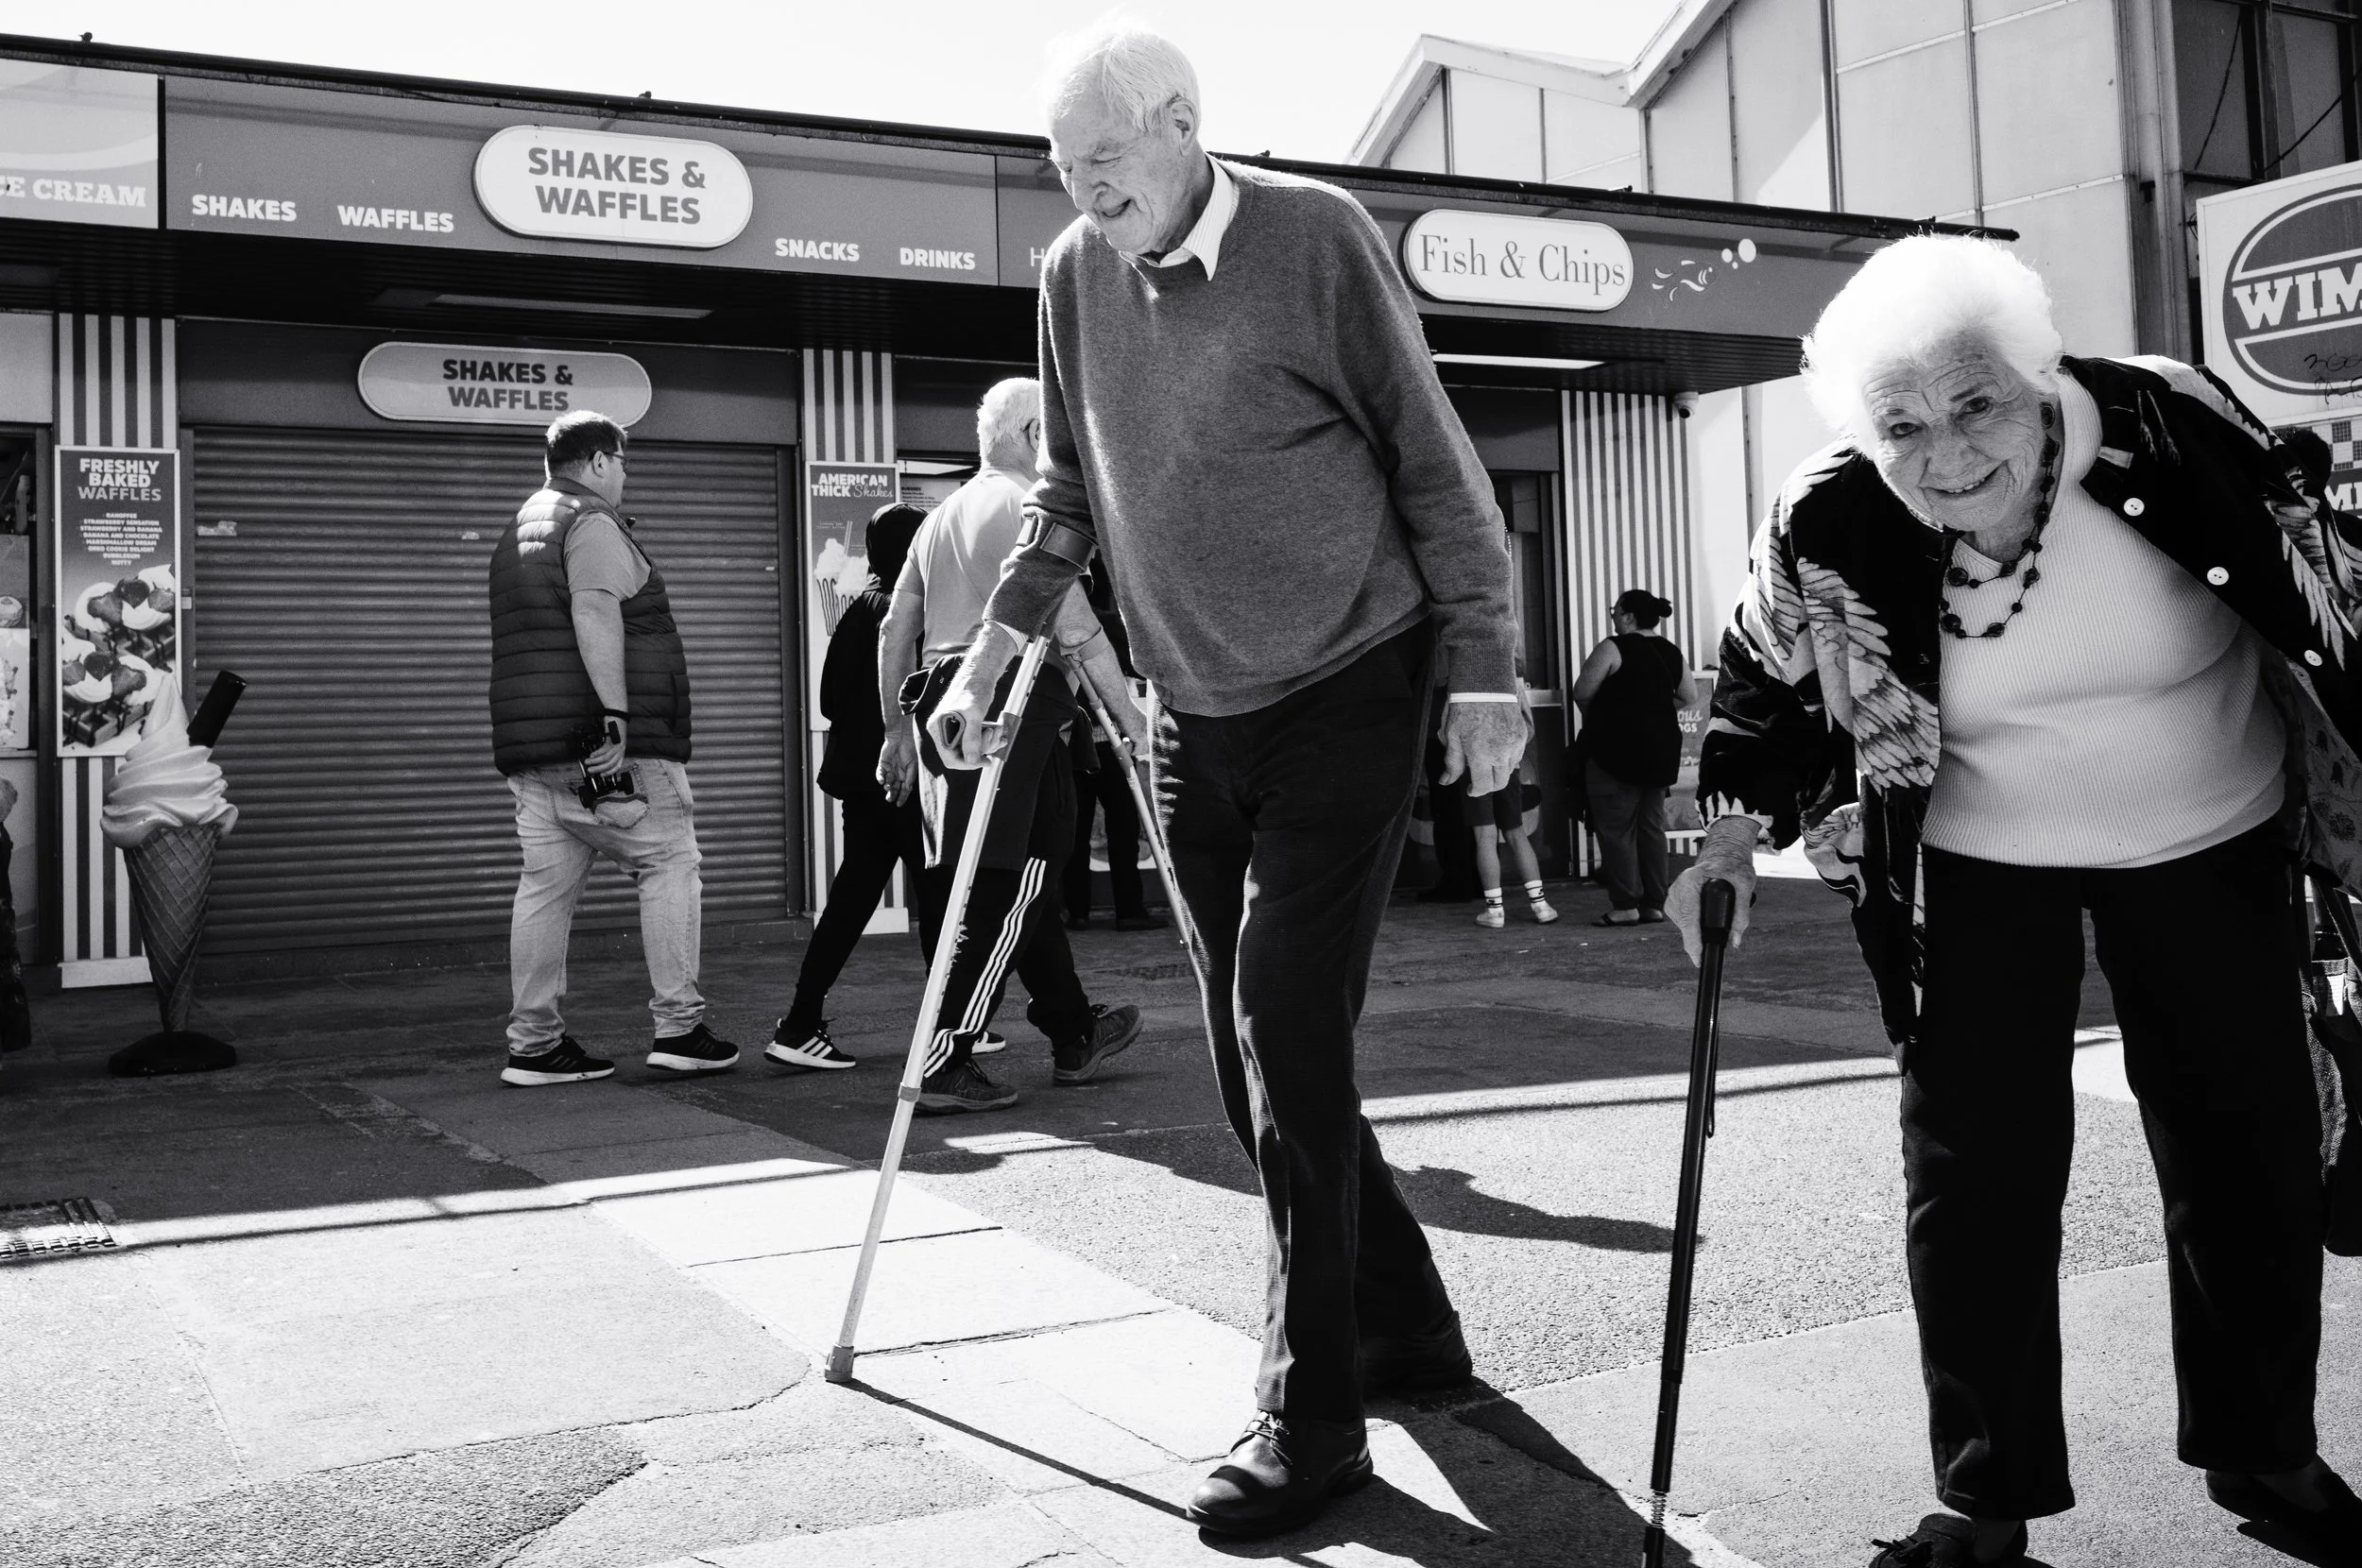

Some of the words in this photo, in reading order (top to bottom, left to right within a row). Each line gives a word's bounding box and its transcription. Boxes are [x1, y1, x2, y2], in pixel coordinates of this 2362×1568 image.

[528, 146, 669, 186] SHAKES
[681, 161, 707, 189] &
[0, 175, 26, 198] E
[32, 178, 146, 208] CREAM
[192, 194, 297, 222] SHAKES
[535, 185, 701, 225] WAFFLES
[337, 205, 454, 233] WAFFLES
[775, 237, 860, 263] SNACKS
[899, 247, 976, 271] DRINKS
[1419, 234, 1489, 277] Fish
[1499, 240, 1527, 280] &
[1539, 243, 1626, 296] Chips
[442, 358, 547, 384] SHAKES
[555, 365, 573, 386] &
[448, 385, 570, 411] WAFFLES
[79, 458, 160, 474] FRESHLY
[89, 472, 151, 487] BAKED
[811, 484, 851, 498] THICK
[852, 483, 894, 499] Shakes
[818, 472, 888, 487] AMERICAN
[77, 486, 162, 501] WAFFLES
